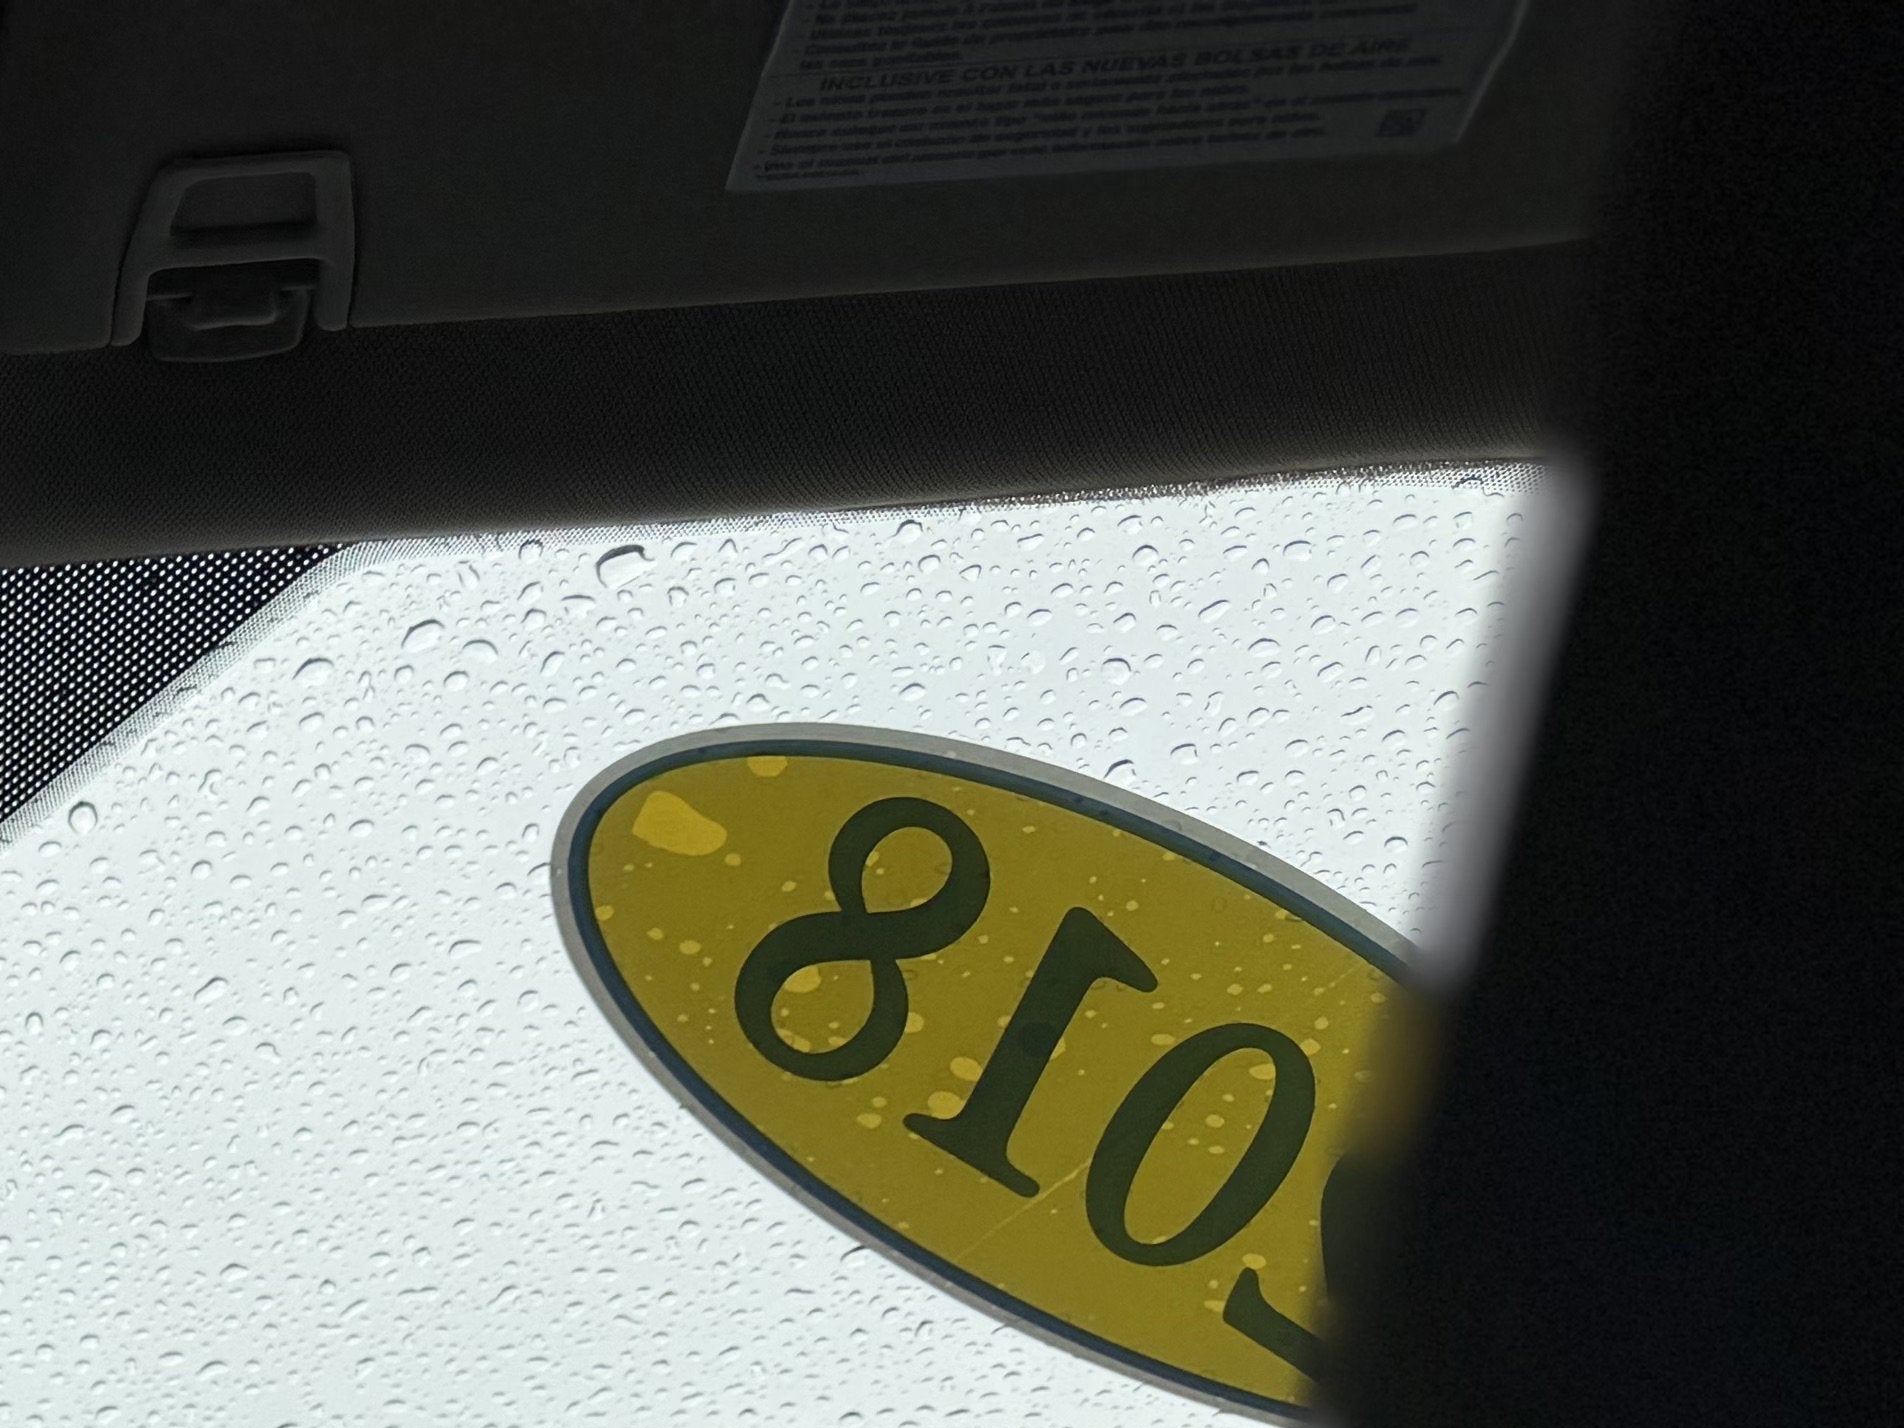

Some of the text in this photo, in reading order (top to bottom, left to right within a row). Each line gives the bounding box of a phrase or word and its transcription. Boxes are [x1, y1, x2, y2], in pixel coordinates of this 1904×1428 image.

[819, 68, 955, 92] INCLUSIVE
[961, 65, 1019, 83] CON
[1025, 60, 1075, 78] LAS
